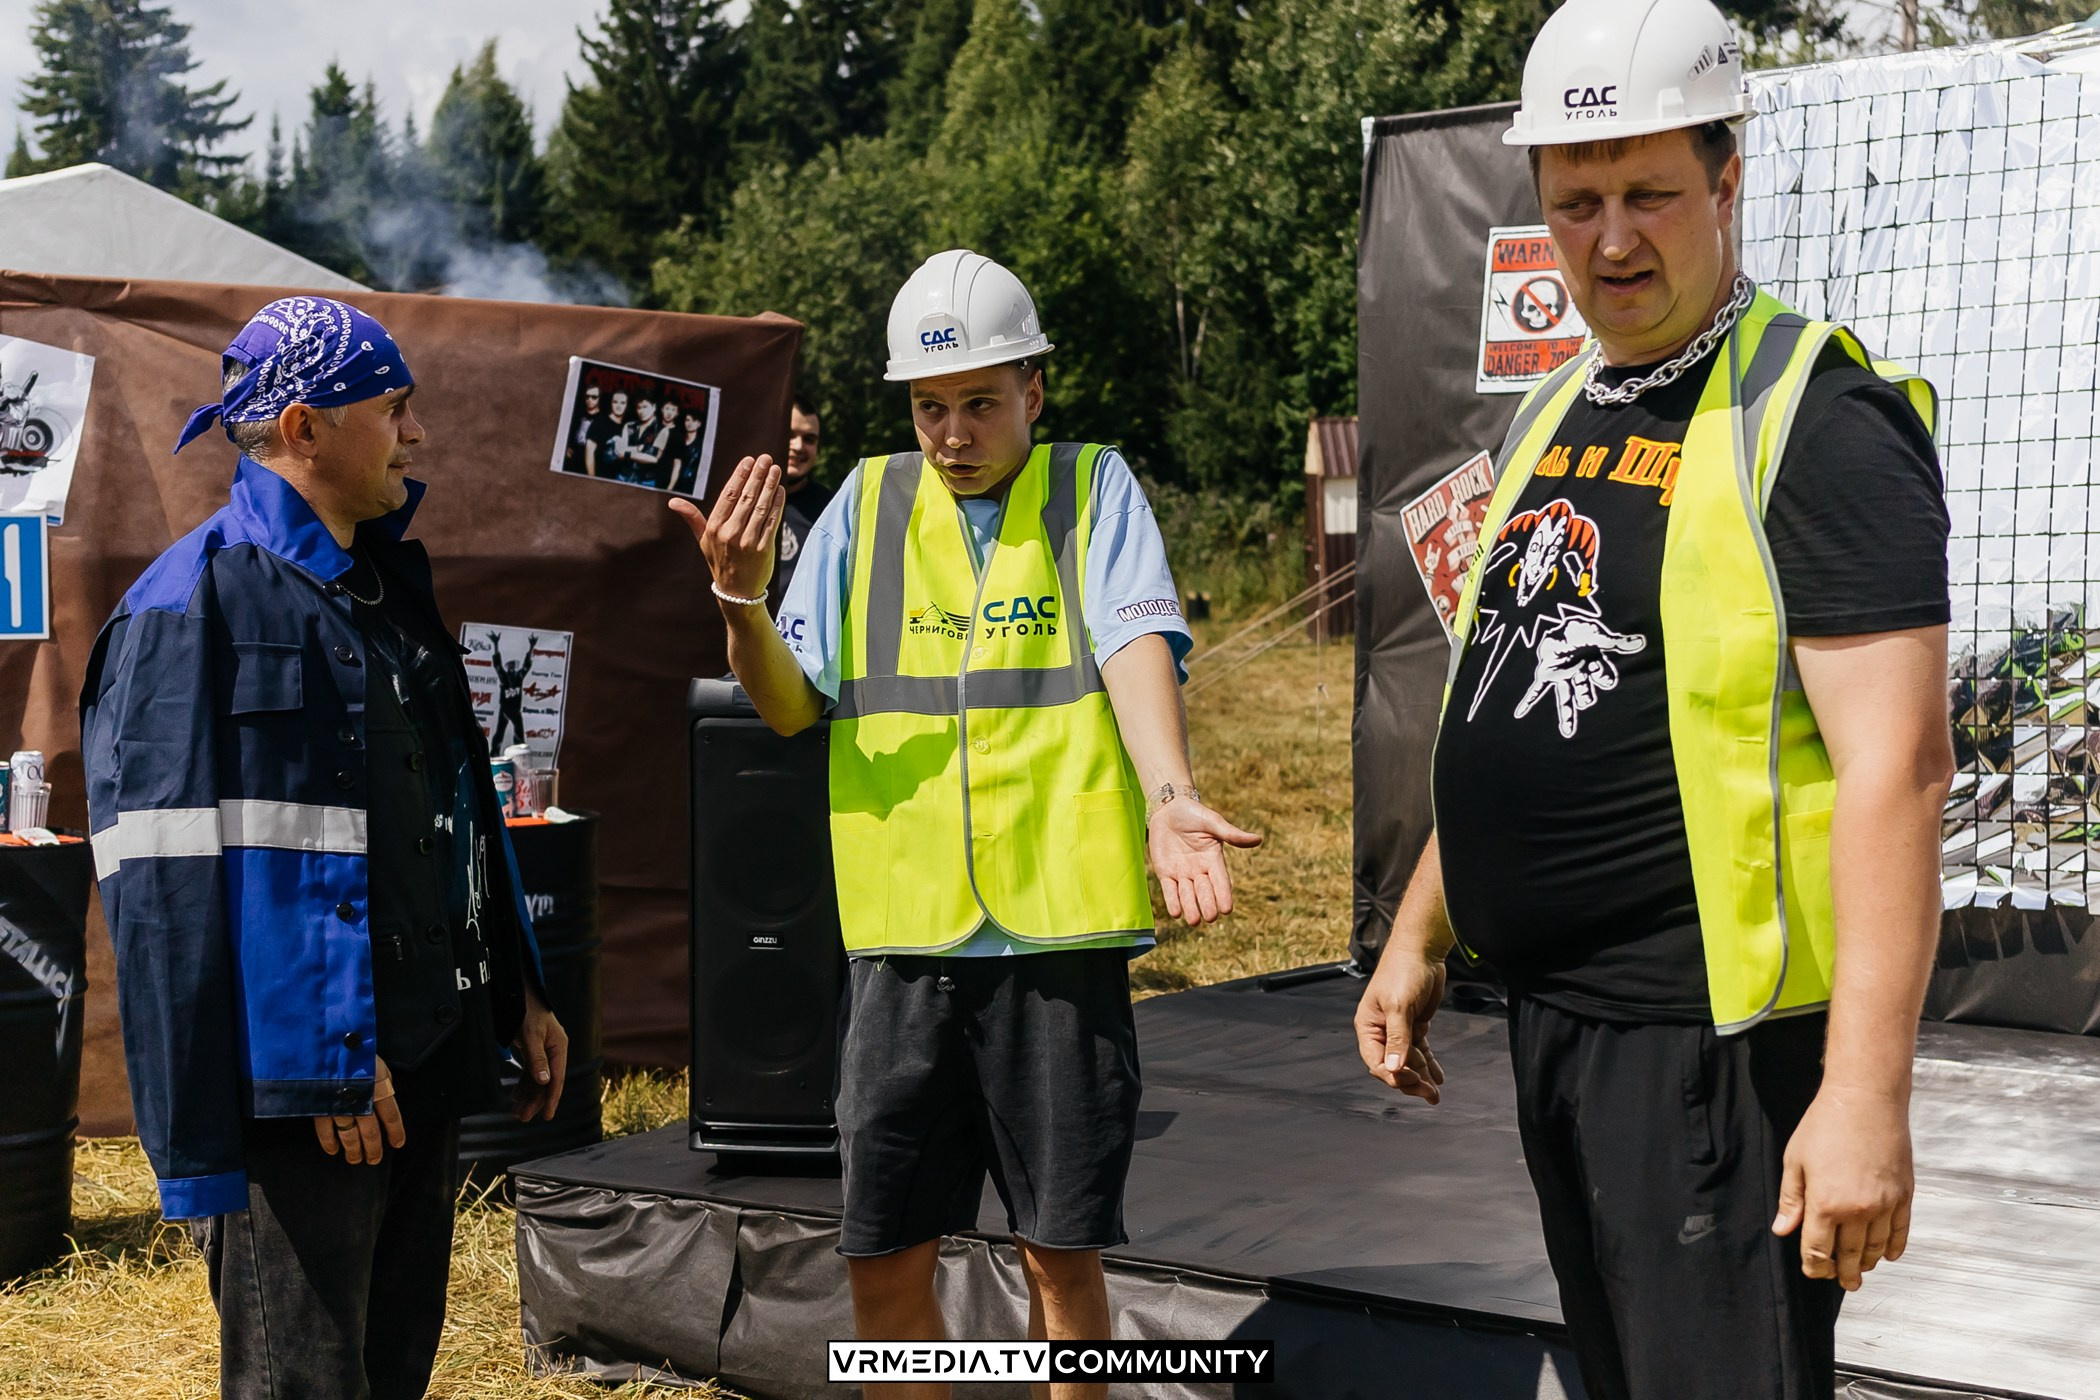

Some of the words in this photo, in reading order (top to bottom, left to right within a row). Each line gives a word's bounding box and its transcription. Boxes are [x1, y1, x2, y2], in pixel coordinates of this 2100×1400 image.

[1564, 85, 1617, 109] СДС
[1565, 108, 1618, 120] УГОЛЬ
[920, 327, 957, 346] СДС
[924, 342, 959, 354] УГОЛЬ
[1485, 353, 1541, 376] DANGER
[1405, 490, 1449, 544] HARD
[1448, 459, 1492, 504] ROCK
[983, 595, 1056, 623] СДС
[985, 623, 1057, 640] УГОЛЬ
